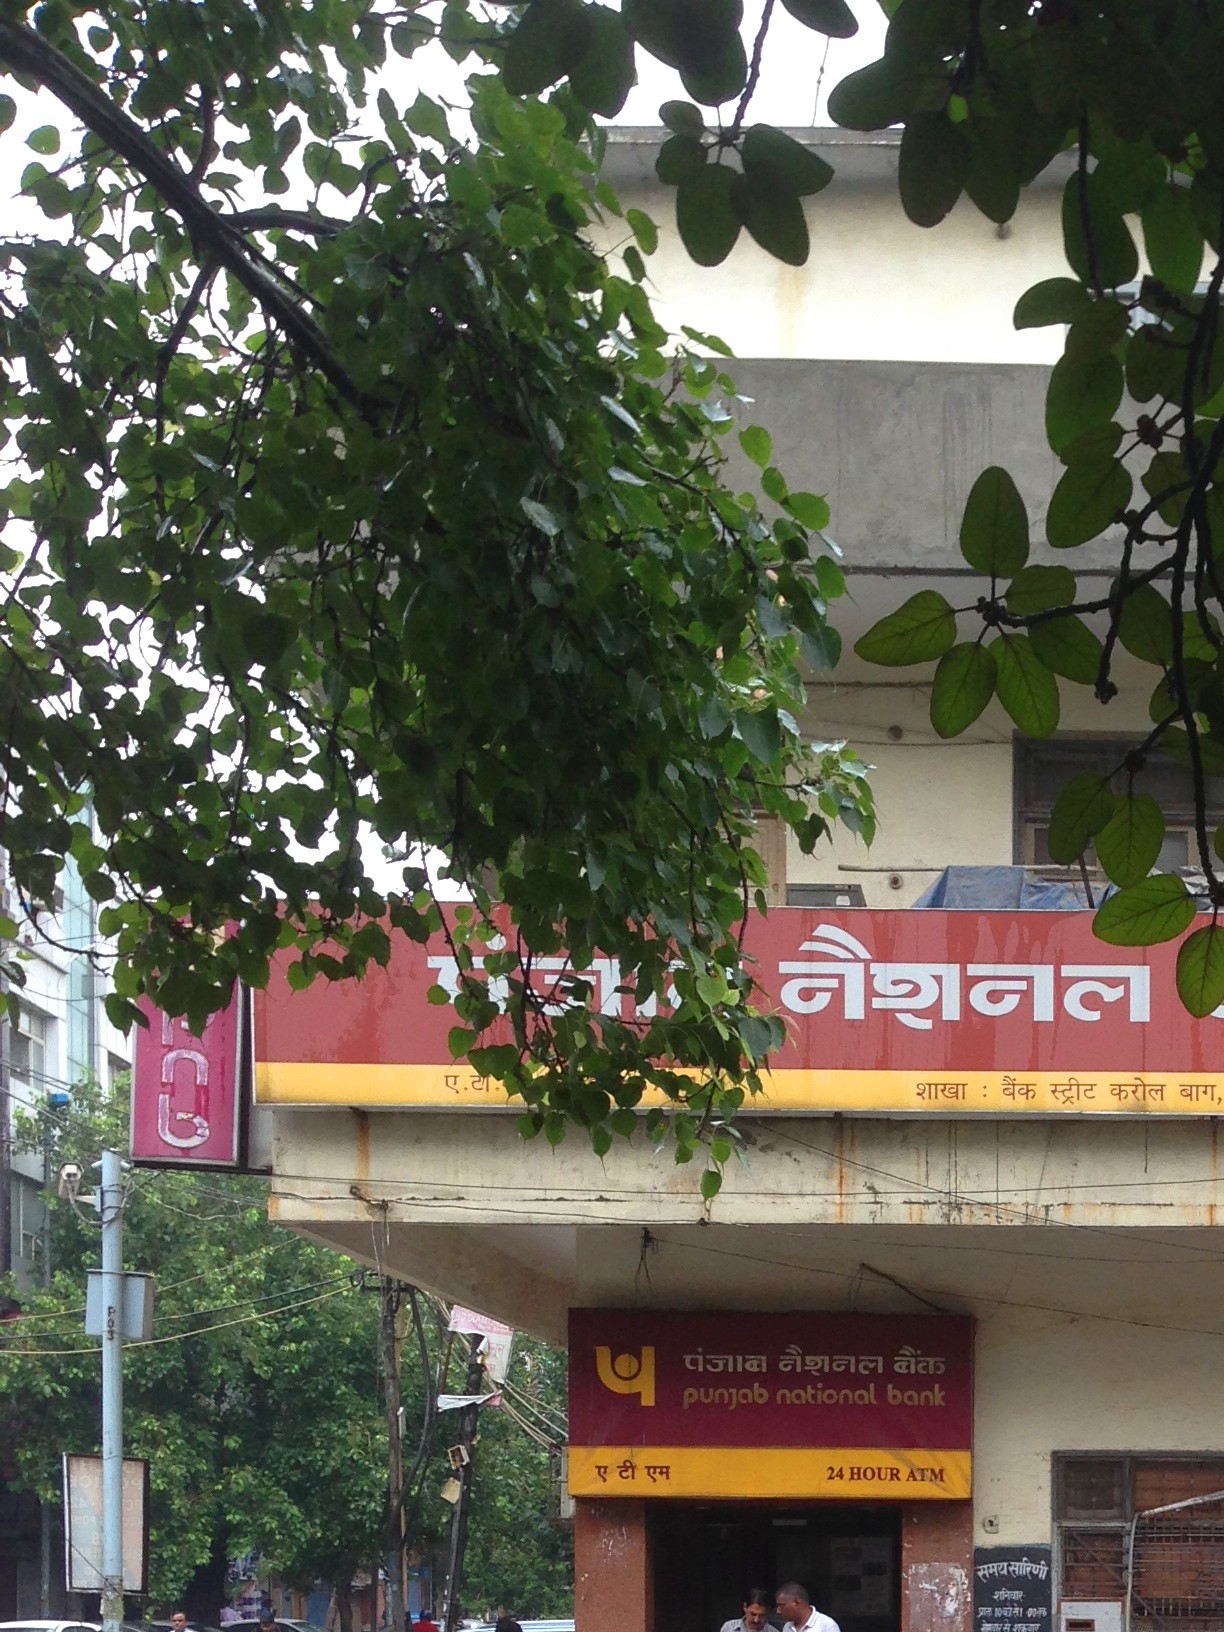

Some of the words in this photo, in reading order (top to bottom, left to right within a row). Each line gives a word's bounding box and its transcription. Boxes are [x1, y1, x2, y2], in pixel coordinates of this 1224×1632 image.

[779, 924, 1150, 1030] नैशनल
[916, 1083, 968, 1100] शाखा
[1001, 1076, 1037, 1101] बैंक
[1050, 1077, 1097, 1104] स्ट्रीट
[1109, 1077, 1165, 1101] करोल
[1179, 1083, 1222, 1105] बाग,
[683, 1348, 768, 1373] पंजाब
[778, 1344, 884, 1376] नैशनल
[893, 1345, 946, 1375] बैंक
[683, 1383, 769, 1410] punjab
[776, 1383, 879, 1406] national
[887, 1383, 946, 1406] bank
[595, 1465, 608, 1482] ए
[617, 1459, 636, 1480] टी
[645, 1465, 670, 1482] एम
[826, 1466, 845, 1481] 24
[849, 1466, 901, 1482] HOUR
[906, 1467, 945, 1482] ATM
[977, 1562, 1008, 1583] समय
